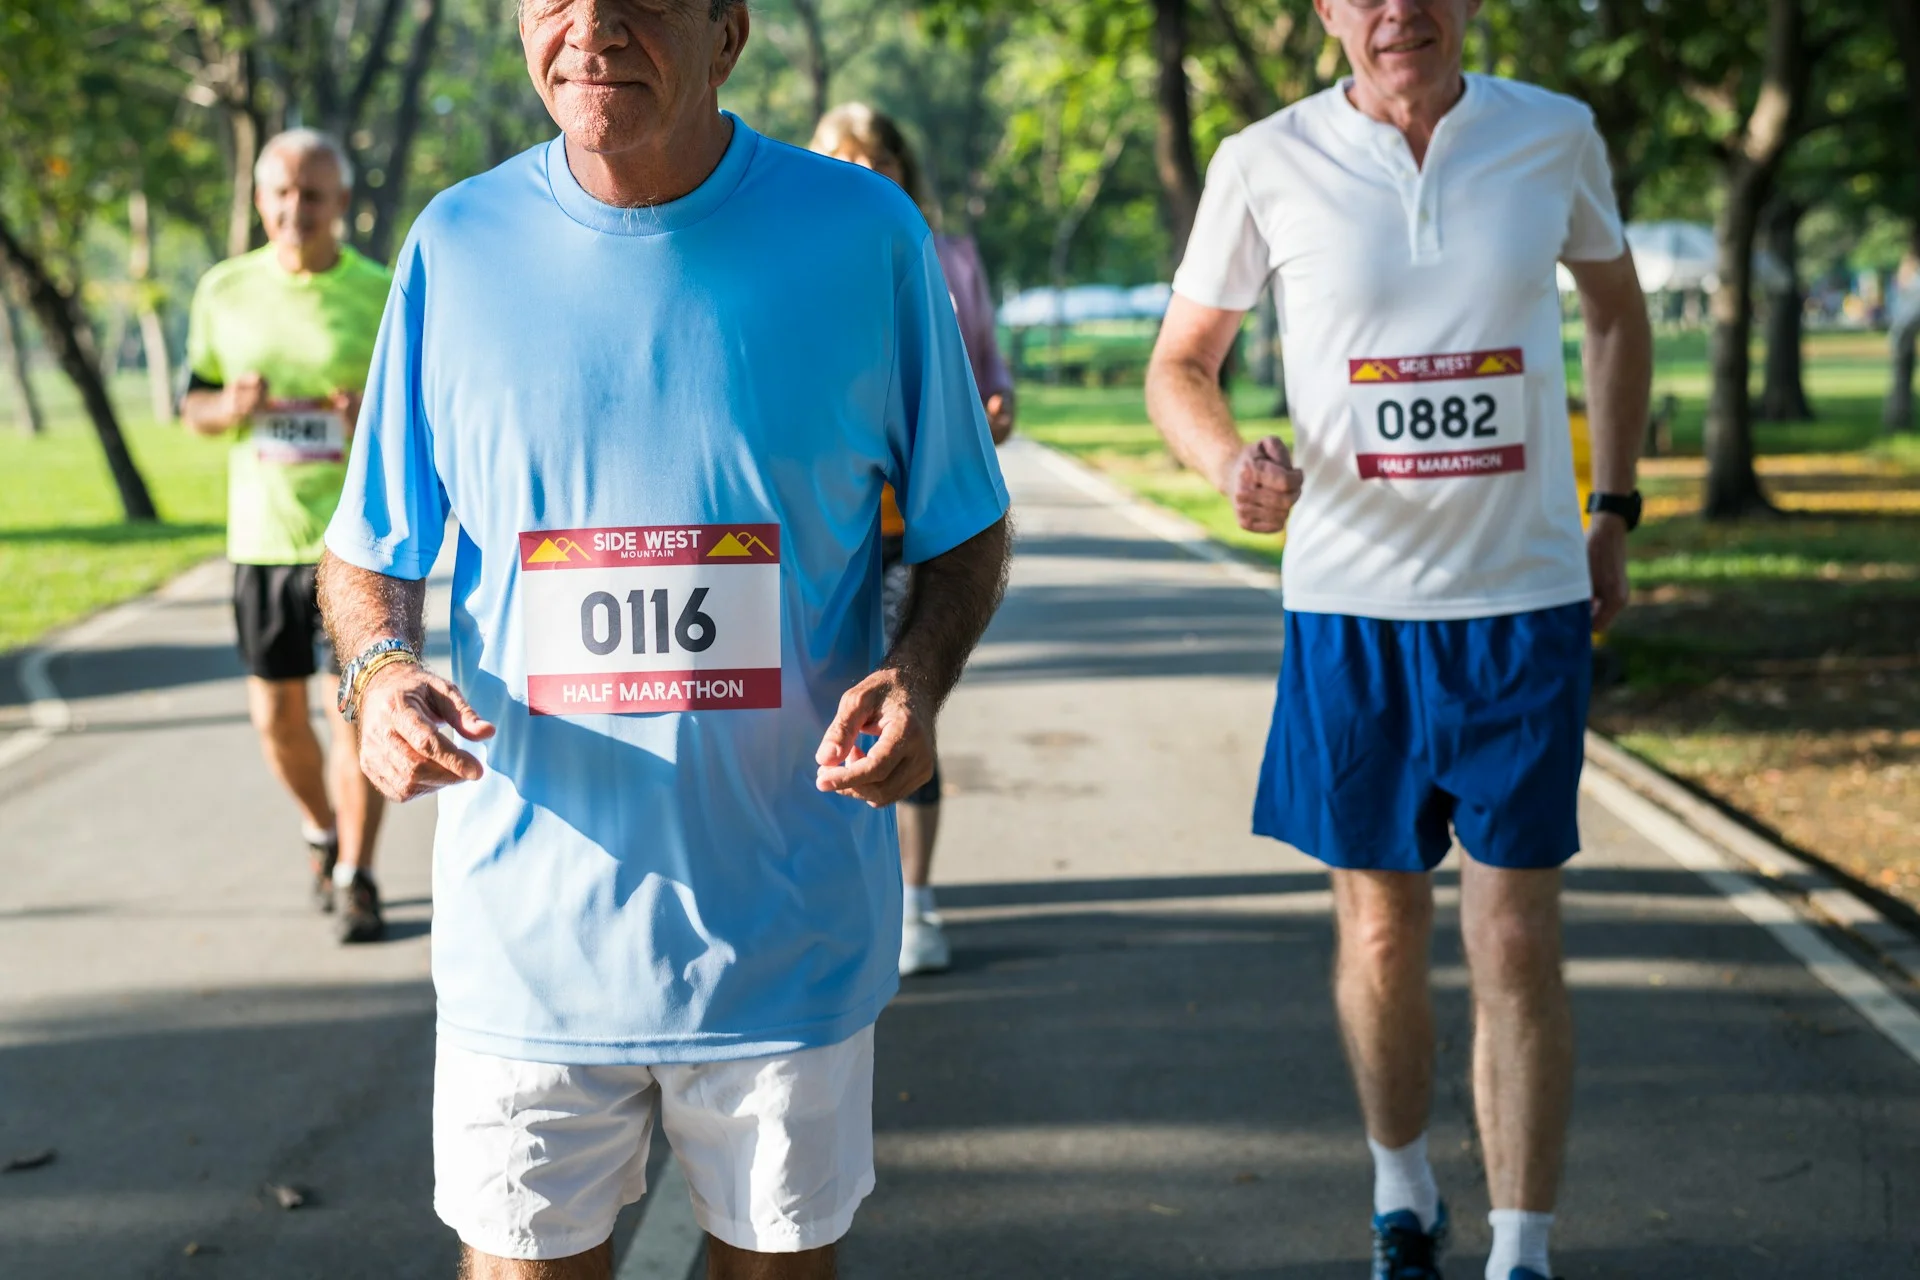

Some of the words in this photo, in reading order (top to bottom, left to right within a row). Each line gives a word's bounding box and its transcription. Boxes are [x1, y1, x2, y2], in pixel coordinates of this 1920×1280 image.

[1398, 358, 1429, 374] SIDE
[1433, 355, 1472, 370] WEST
[1377, 392, 1498, 441] 0882
[1377, 457, 1415, 474] HALF
[1417, 454, 1502, 473] MARATHON
[593, 532, 637, 551] SIDE
[643, 530, 702, 549] WEST
[620, 549, 674, 561] MOUNTAIN
[580, 587, 717, 656] 0116
[563, 683, 613, 703] HALF
[620, 679, 744, 702] MARATHON
